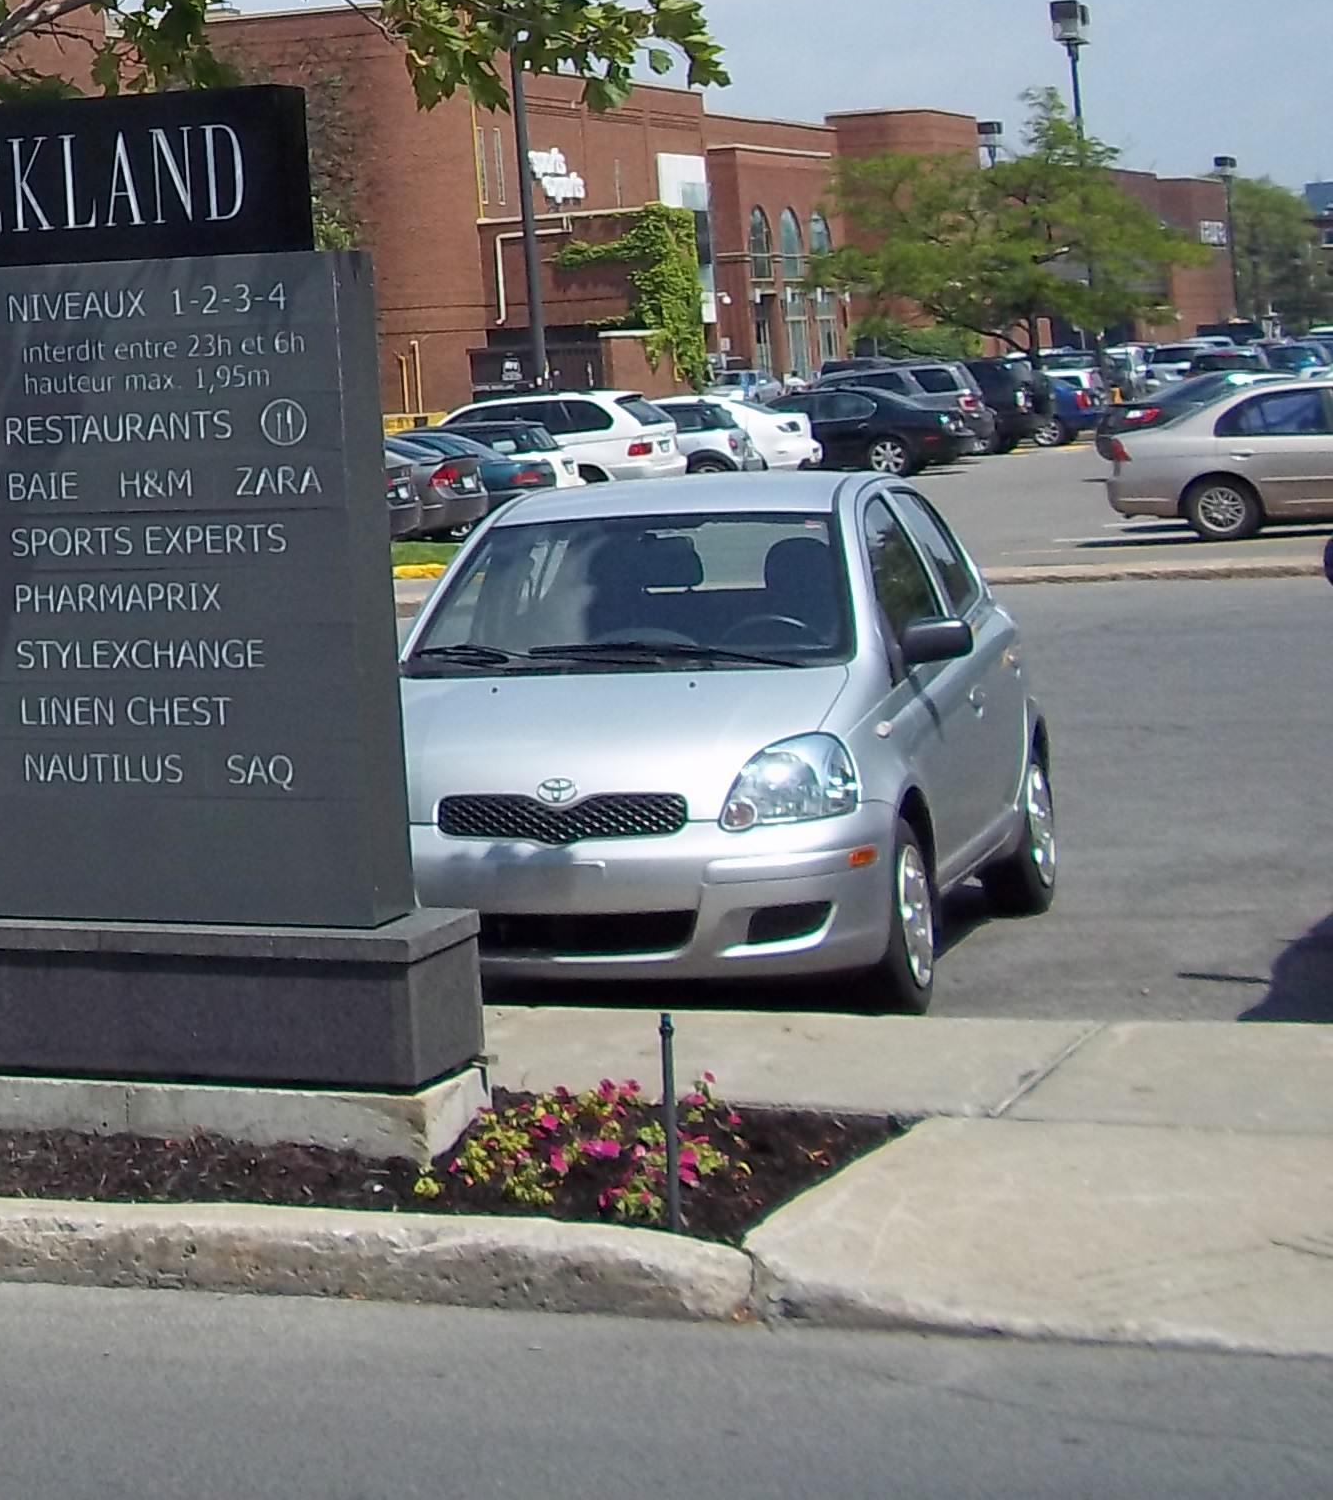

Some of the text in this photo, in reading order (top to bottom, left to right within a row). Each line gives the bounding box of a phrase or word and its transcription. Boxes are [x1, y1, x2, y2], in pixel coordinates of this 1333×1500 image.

[7, 289, 147, 323] NIVEAUX
[171, 282, 288, 317] 1-2-3-4
[22, 330, 306, 366] interdit entre 23h et 6h
[23, 364, 271, 397] hauteur max. 1,95m
[4, 409, 233, 446] RESTAURANTS
[7, 470, 80, 502] BAIE
[119, 468, 194, 498] H&M
[235, 465, 323, 497] ZARA
[10, 523, 287, 558] SPORTS EXPERTS
[14, 582, 222, 613] PHARMAPRIX
[16, 638, 266, 670] STYLEXCHANGE
[20, 696, 233, 727] LINEN CHEST
[23, 753, 295, 791] NAUTILUS SAQ
